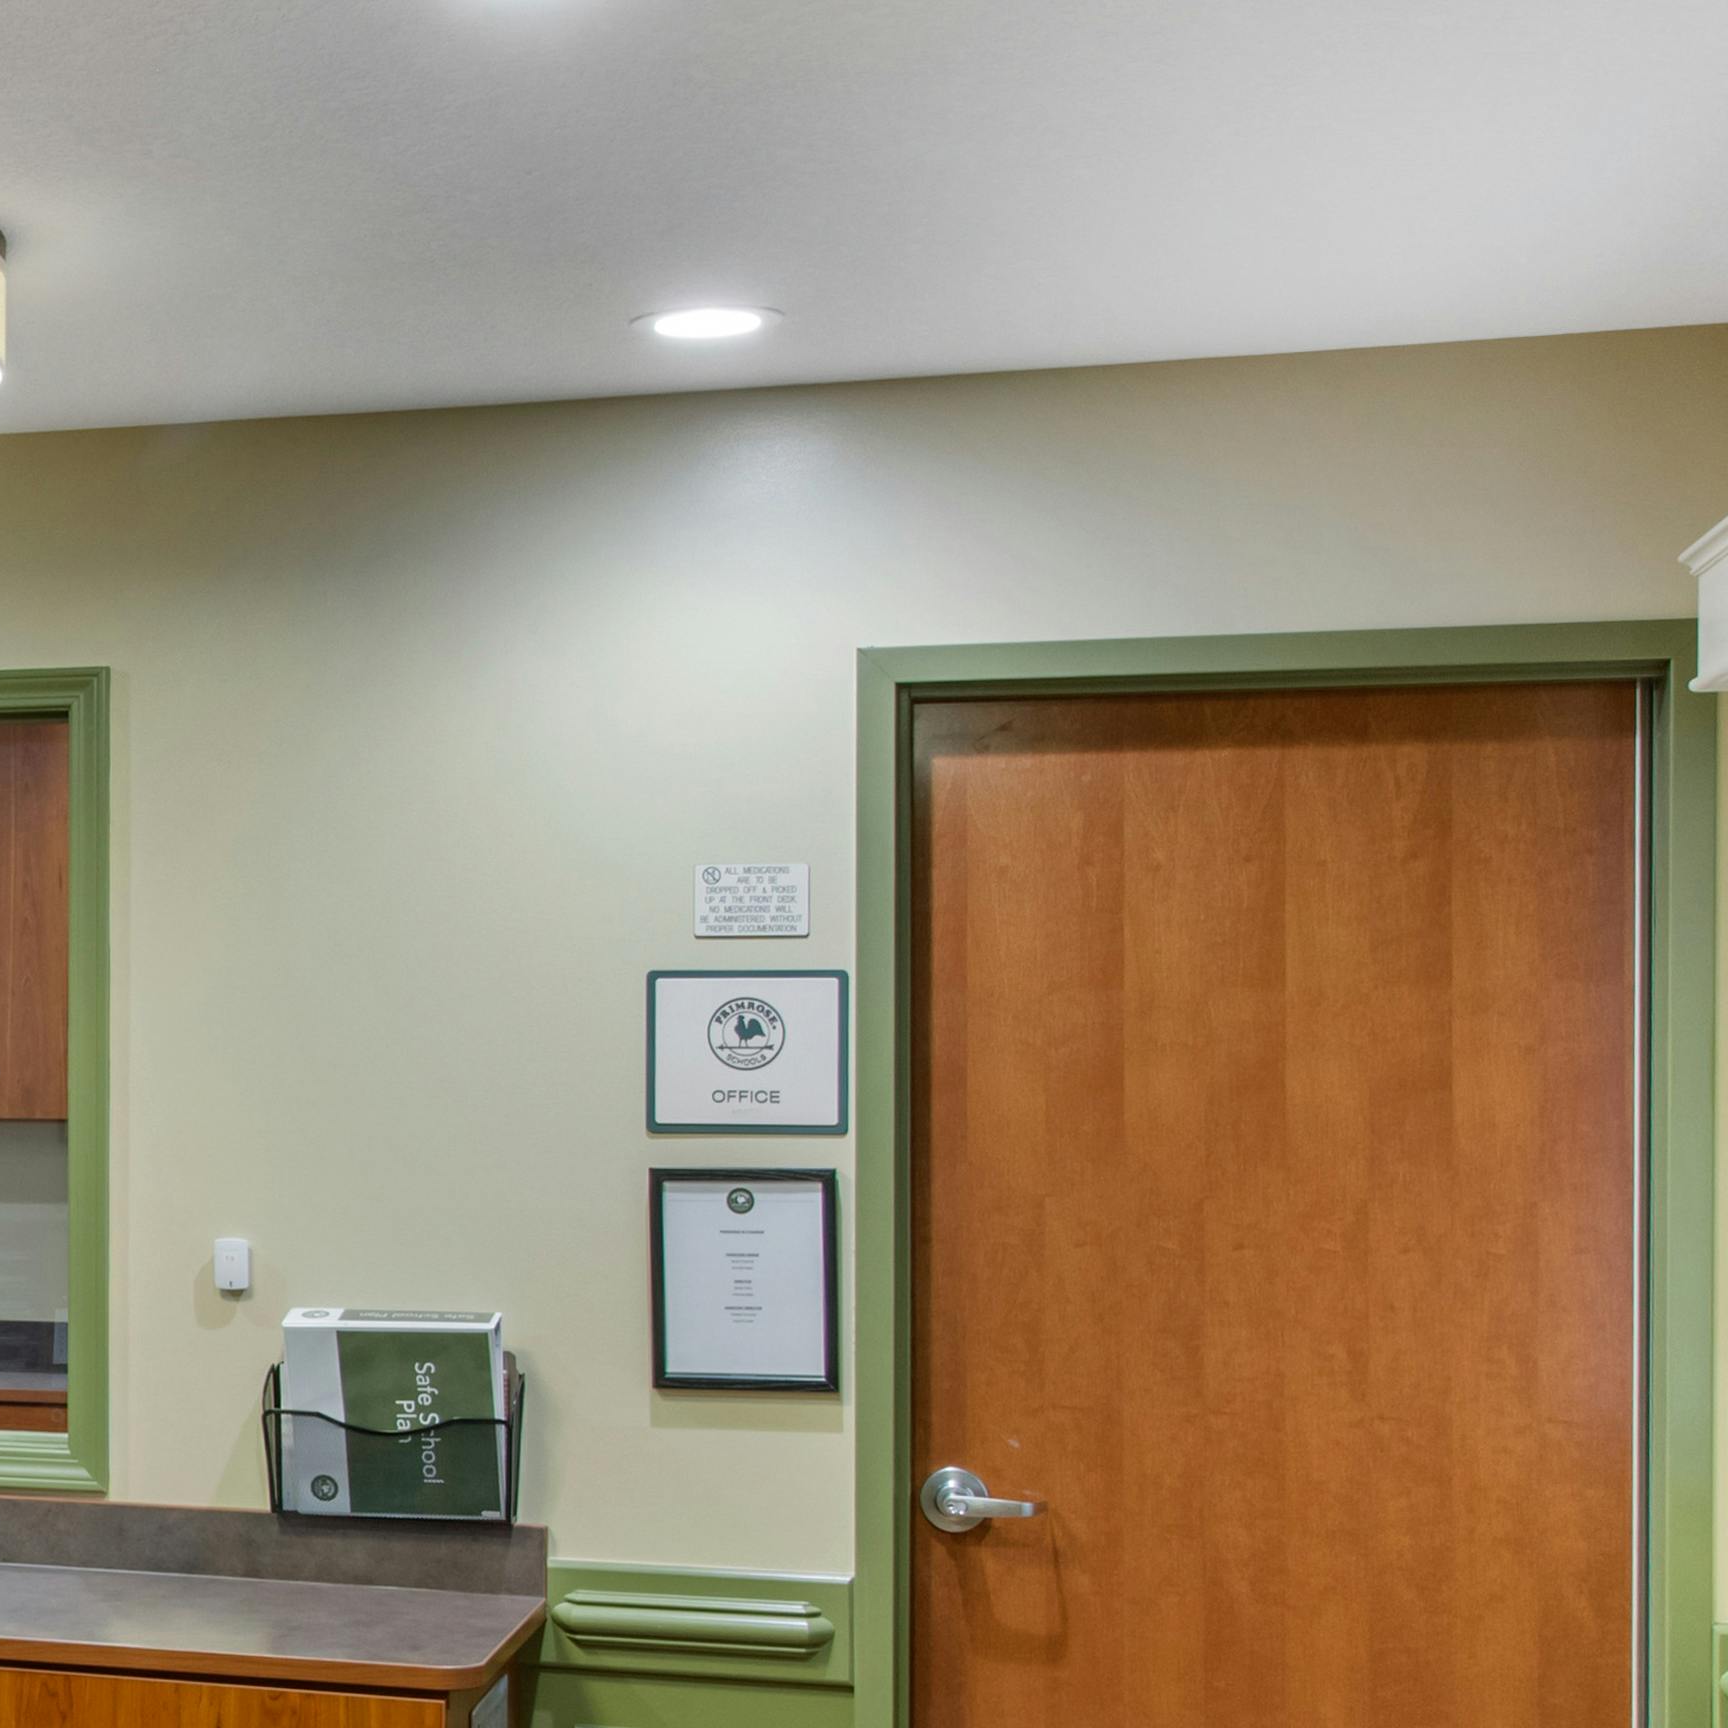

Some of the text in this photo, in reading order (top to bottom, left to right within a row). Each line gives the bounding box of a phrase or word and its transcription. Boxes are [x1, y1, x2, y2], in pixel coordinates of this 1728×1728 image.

[725, 866, 790, 875] ALL MEDICATIONS
[736, 876, 750, 884] ARE
[756, 876, 764, 884] TO
[706, 886, 739, 894] DROPPED
[743, 886, 756, 894] OFF
[771, 886, 797, 894] PICKED
[704, 896, 715, 904] UP
[719, 896, 727, 904] AT
[732, 896, 744, 904] THE
[749, 896, 772, 904] FRONT
[709, 905, 793, 913] NO MEDICATIONS WILL
[713, 915, 766, 923] ADMINISTERED
[769, 914, 802, 922] WITHOUT
[726, 1053, 767, 1066] SCHOOLS
[711, 1089, 781, 1104] OFFICE
[414, 1362, 438, 1406] Safe
